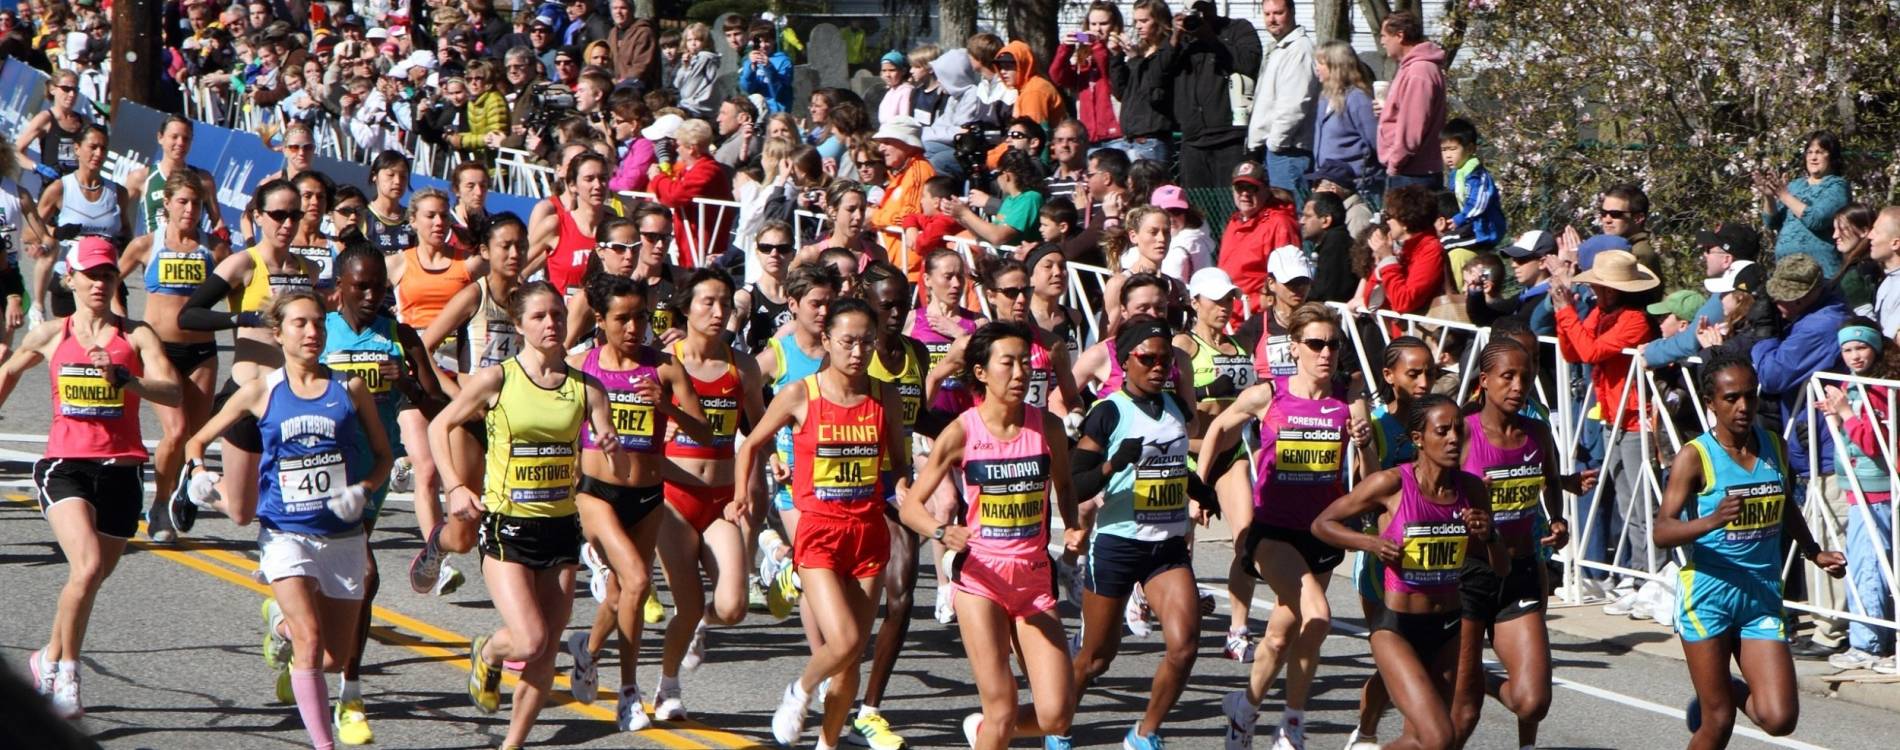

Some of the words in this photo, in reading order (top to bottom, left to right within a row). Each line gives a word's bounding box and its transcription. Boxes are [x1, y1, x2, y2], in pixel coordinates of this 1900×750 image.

[164, 263, 202, 281] PIERS
[64, 384, 121, 400] CONNELLY
[280, 415, 336, 442] NORTHSIDE
[1287, 415, 1334, 427] FORESTALE
[818, 424, 878, 442] CHINA
[1303, 429, 1341, 440] adidas
[538, 444, 573, 455] adidas
[842, 445, 878, 456] adidas
[1282, 448, 1337, 464] GENOVESE
[303, 453, 343, 467] adidas
[515, 464, 571, 481] WESTOVER
[834, 461, 862, 483] JIA
[297, 471, 331, 495] 40
[1007, 480, 1044, 491] adidas
[1750, 483, 1783, 496] adidas
[1431, 523, 1467, 535] adidas
[1417, 541, 1458, 566] TUNE
